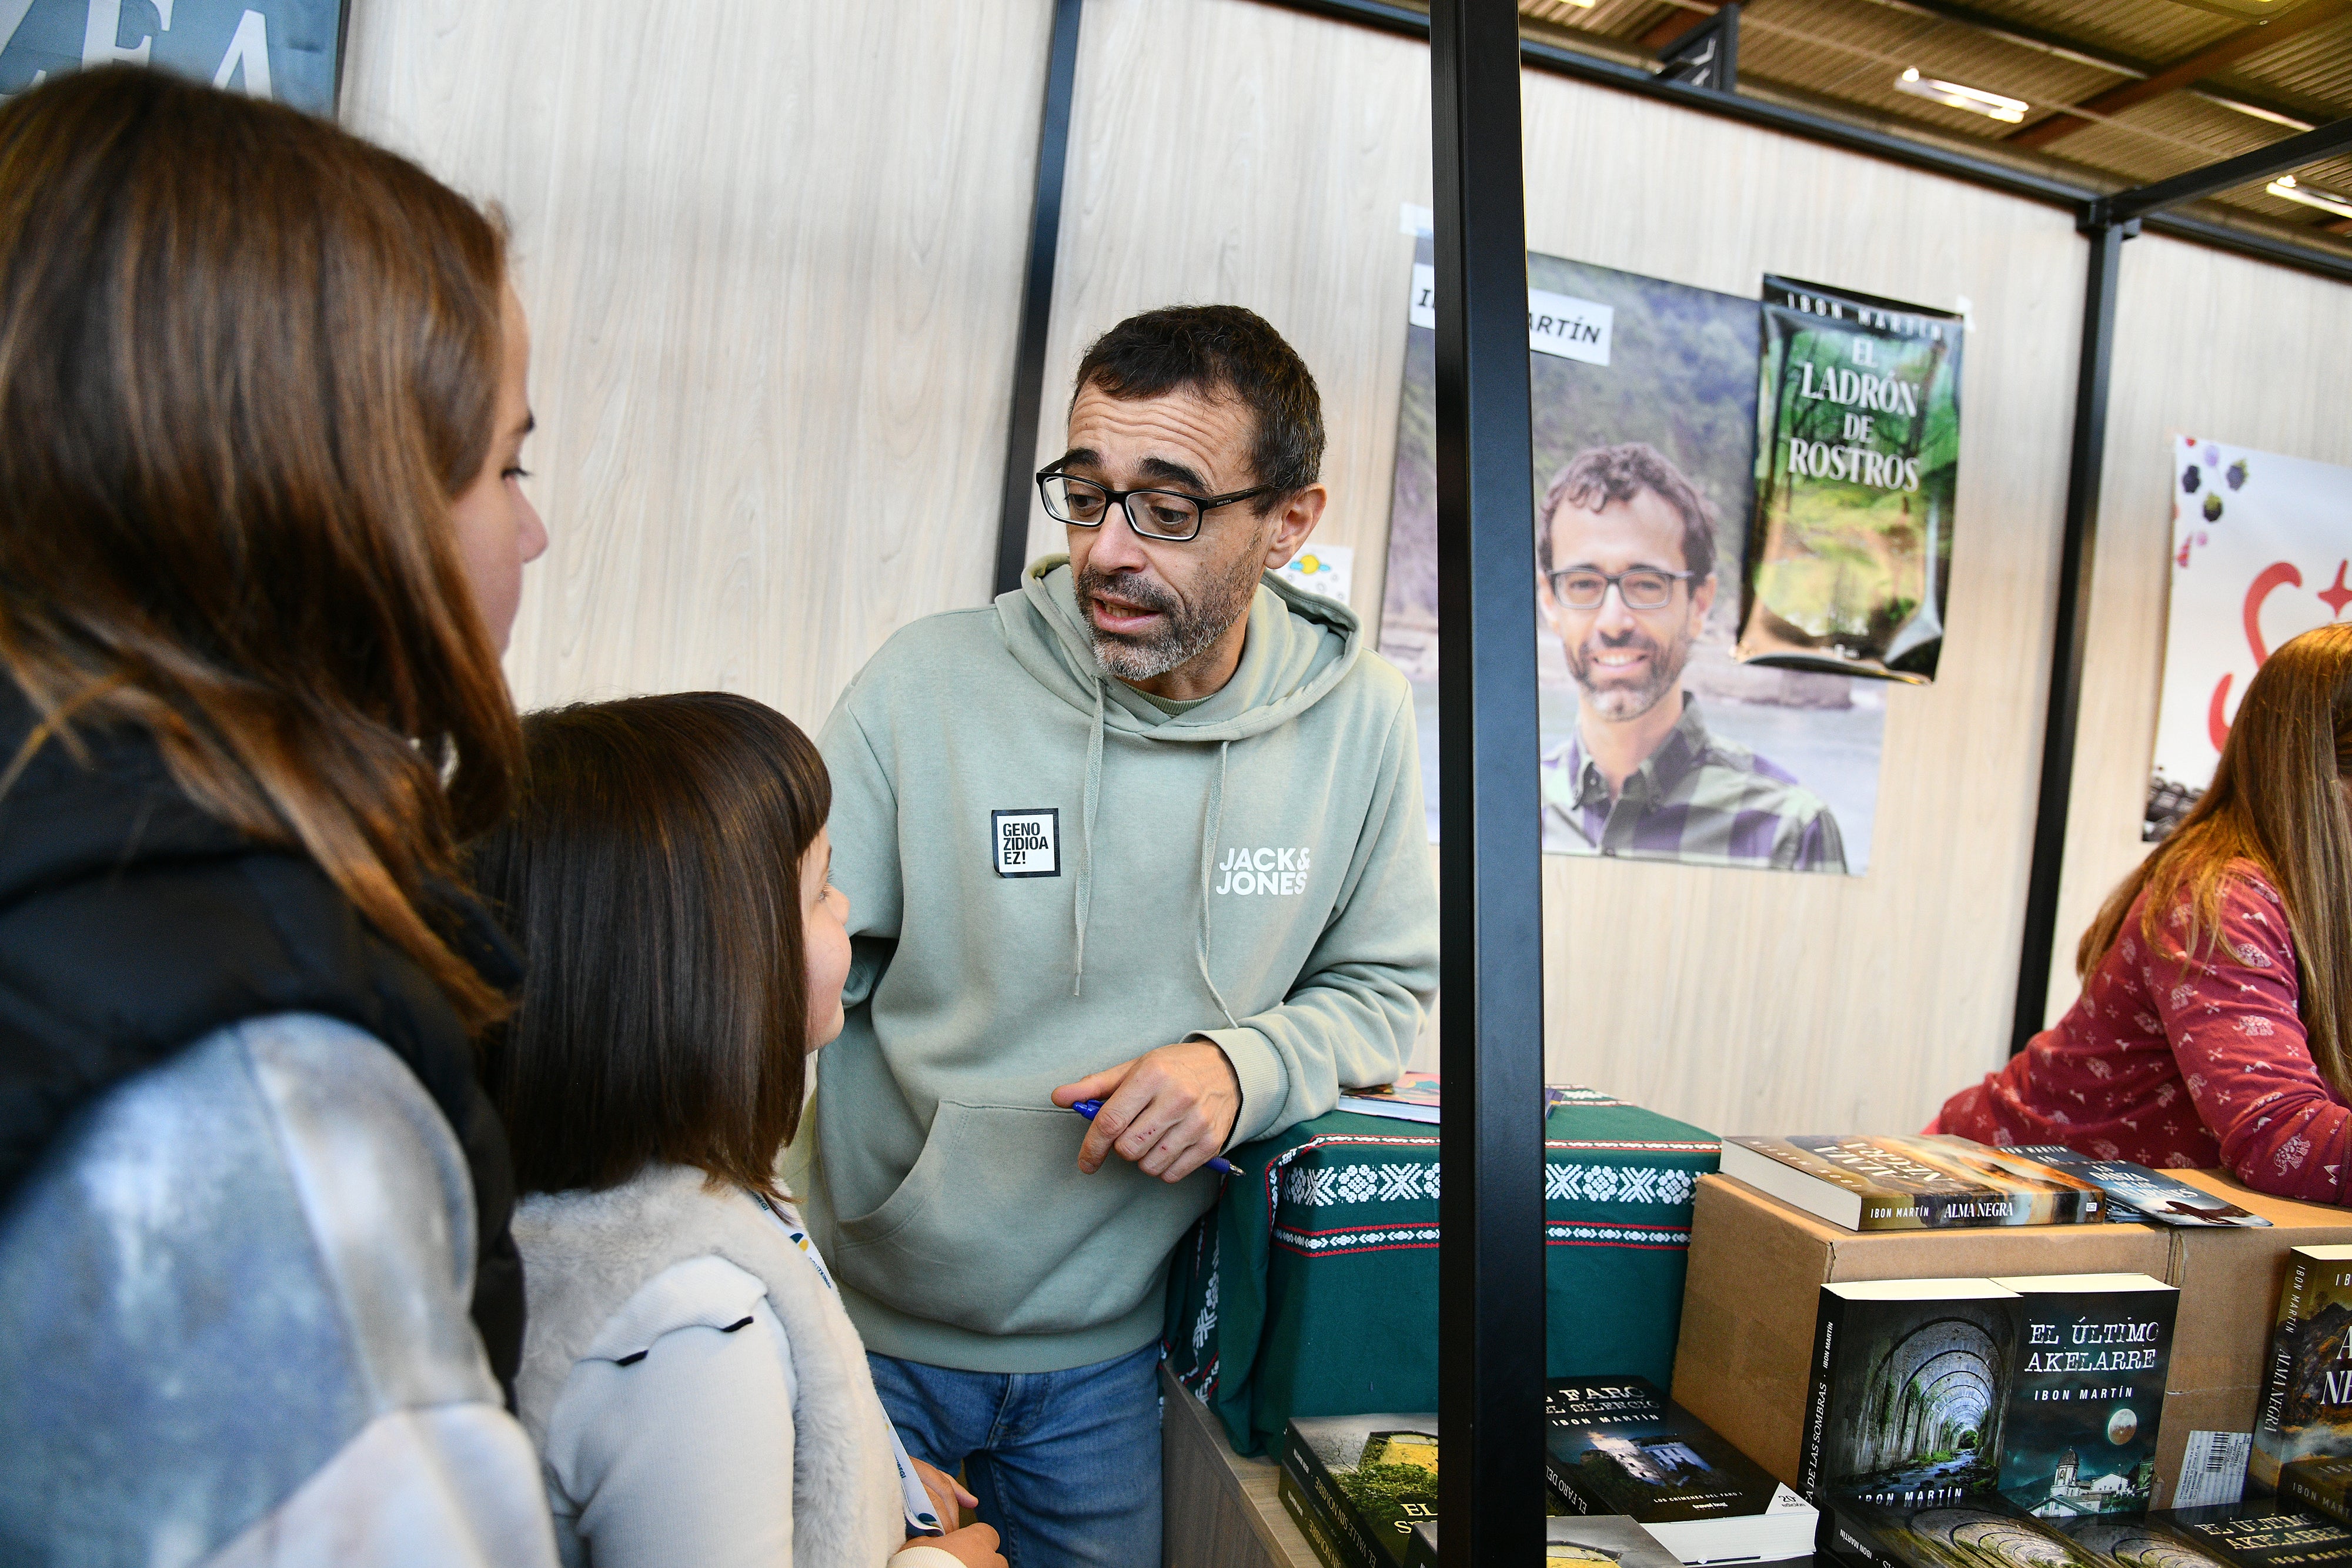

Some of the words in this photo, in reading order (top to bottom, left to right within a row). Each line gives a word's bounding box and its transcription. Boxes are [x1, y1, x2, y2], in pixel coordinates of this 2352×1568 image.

[1852, 336, 1879, 368] EL
[1800, 360, 1920, 418] LADRÓN
[1843, 412, 1875, 444] DE
[1788, 437, 1920, 493] ROSTROS
[1003, 822, 1040, 837] GENO
[1003, 836, 1049, 851] ZIDIOA
[1004, 851, 1025, 865] EZ!
[1215, 871, 1308, 895] JONES
[1870, 1208, 1892, 1218] IBON
[1896, 1205, 1929, 1218] MARTÍN
[1944, 1203, 1975, 1218] ALMA
[1977, 1202, 2013, 1217] NEGRA
[2293, 1265, 2306, 1290] IBON
[2336, 1273, 2352, 1286] IB
[2285, 1293, 2300, 1333] MARTÍN
[1825, 1321, 1834, 1350] MARTÍN
[2029, 1323, 2060, 1345] EL
[2072, 1316, 2160, 1345] ÚLTIMO
[2024, 1348, 2156, 1373] AKELARRE
[2273, 1348, 2291, 1386] ALMA
[1559, 1386, 1646, 1402] FARO
[2034, 1389, 2070, 1401] IBON
[2079, 1385, 2133, 1400] MARTÍN
[1569, 1400, 1661, 1413] SILENCIO
[1813, 1382, 1828, 1443] SOMBRAS
[2264, 1387, 2284, 1432] NEGRA
[1552, 1417, 1592, 1427] IBON
[1810, 1443, 1819, 1469] LAS
[1808, 1469, 1816, 1489] DE
[1314, 1476, 1338, 1517] NOMBRE
[1558, 1479, 1578, 1505] FARO
[1904, 1486, 1963, 1501] MARTÍN
[2293, 1482, 2317, 1500] IBON
[2323, 1497, 2351, 1518] MART
[1400, 1503, 1438, 1516] EL
[1578, 1497, 1588, 1515] EL
[1337, 1507, 1349, 1530] SIN
[2194, 1523, 2234, 1535] EL
[1308, 1519, 1332, 1560] NOMBRE
[1348, 1523, 1367, 1558] VALLE
[1840, 1529, 1859, 1549] MARTÍN
[1859, 1544, 1872, 1559] IBON
